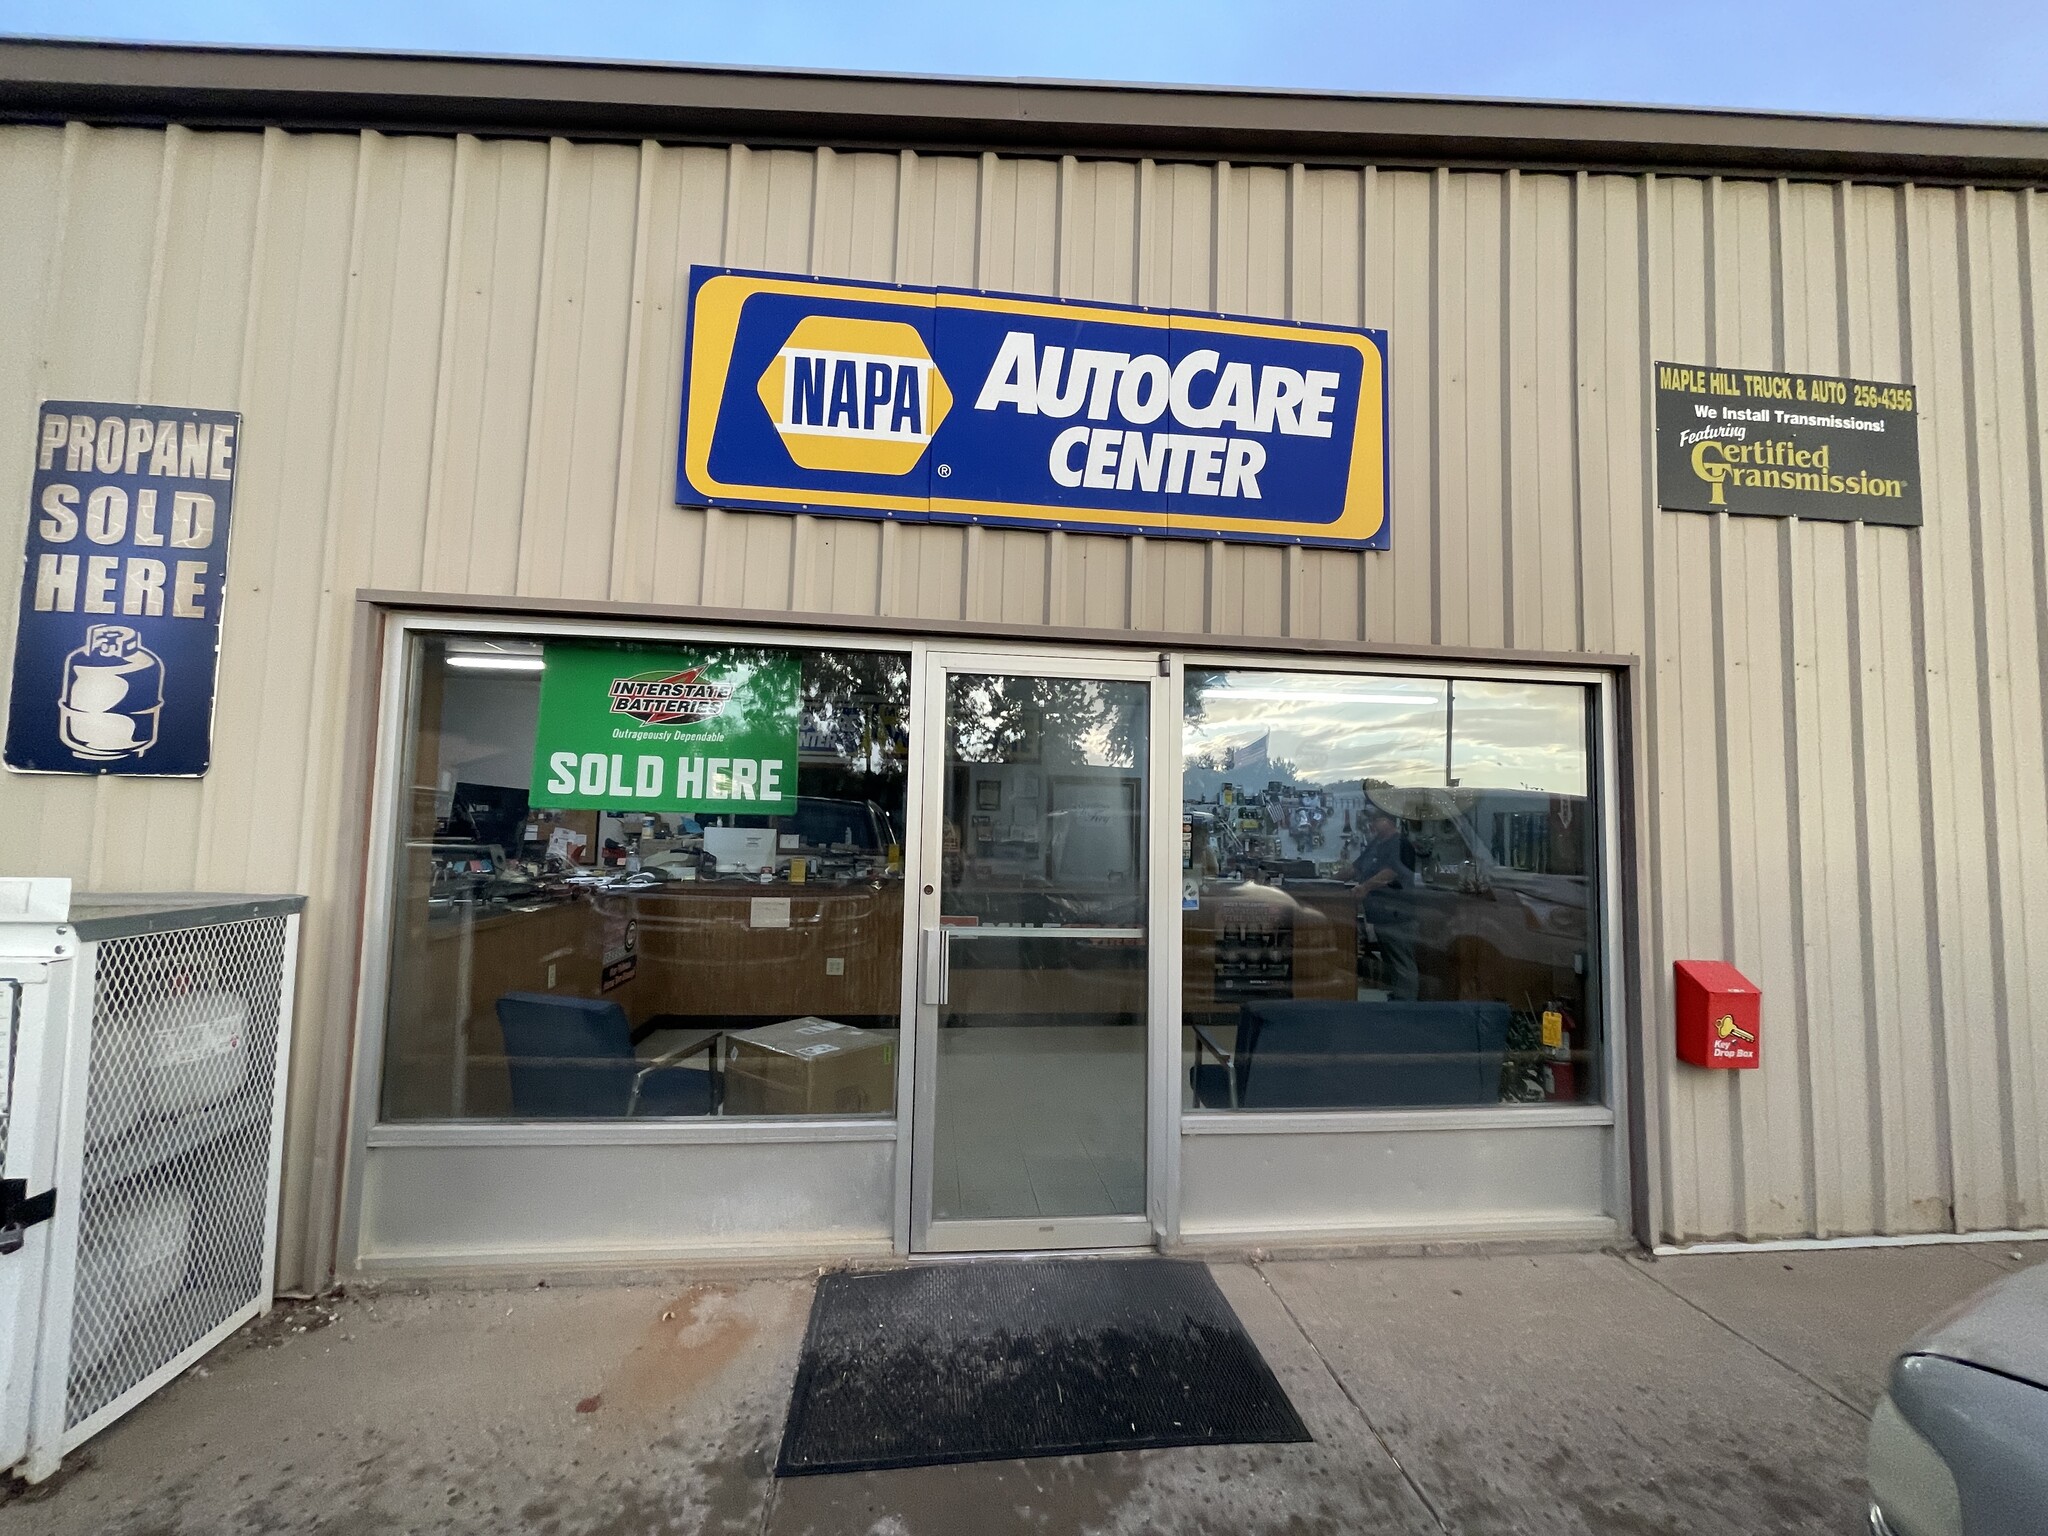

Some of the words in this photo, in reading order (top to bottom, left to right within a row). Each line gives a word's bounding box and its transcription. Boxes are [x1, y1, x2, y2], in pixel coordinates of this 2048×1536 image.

[791, 356, 924, 435] NAPA
[974, 331, 1340, 440] AUTOCARE
[1660, 366, 1705, 394] MAPLE
[1710, 372, 1740, 396] HILL
[1744, 375, 1794, 400] TRUCK
[1796, 379, 1807, 401] &
[1811, 380, 1847, 405] AUTO
[1854, 385, 1912, 411] 256-4356
[1679, 423, 1746, 447] Featuring
[1694, 405, 1717, 419] We
[1722, 406, 1770, 423] Install
[1774, 410, 1885, 432] Transmissions!
[38, 414, 234, 480] PROPANE
[1049, 426, 1266, 499] CENTER
[1691, 439, 1830, 483] Certified
[1703, 463, 1903, 505] Transmission
[39, 484, 216, 548] SOLD
[34, 554, 209, 619] HERE
[612, 682, 733, 699] INTERSTATE
[614, 699, 722, 714] BATTERIES
[612, 728, 672, 743] Outrageously
[673, 730, 725, 743] Dependable
[547, 752, 664, 797] SOLD
[676, 757, 782, 801] HERE
[1714, 1040, 1731, 1050] Key
[1714, 1049, 1735, 1058] Drop
[1736, 1049, 1753, 1057] Box
